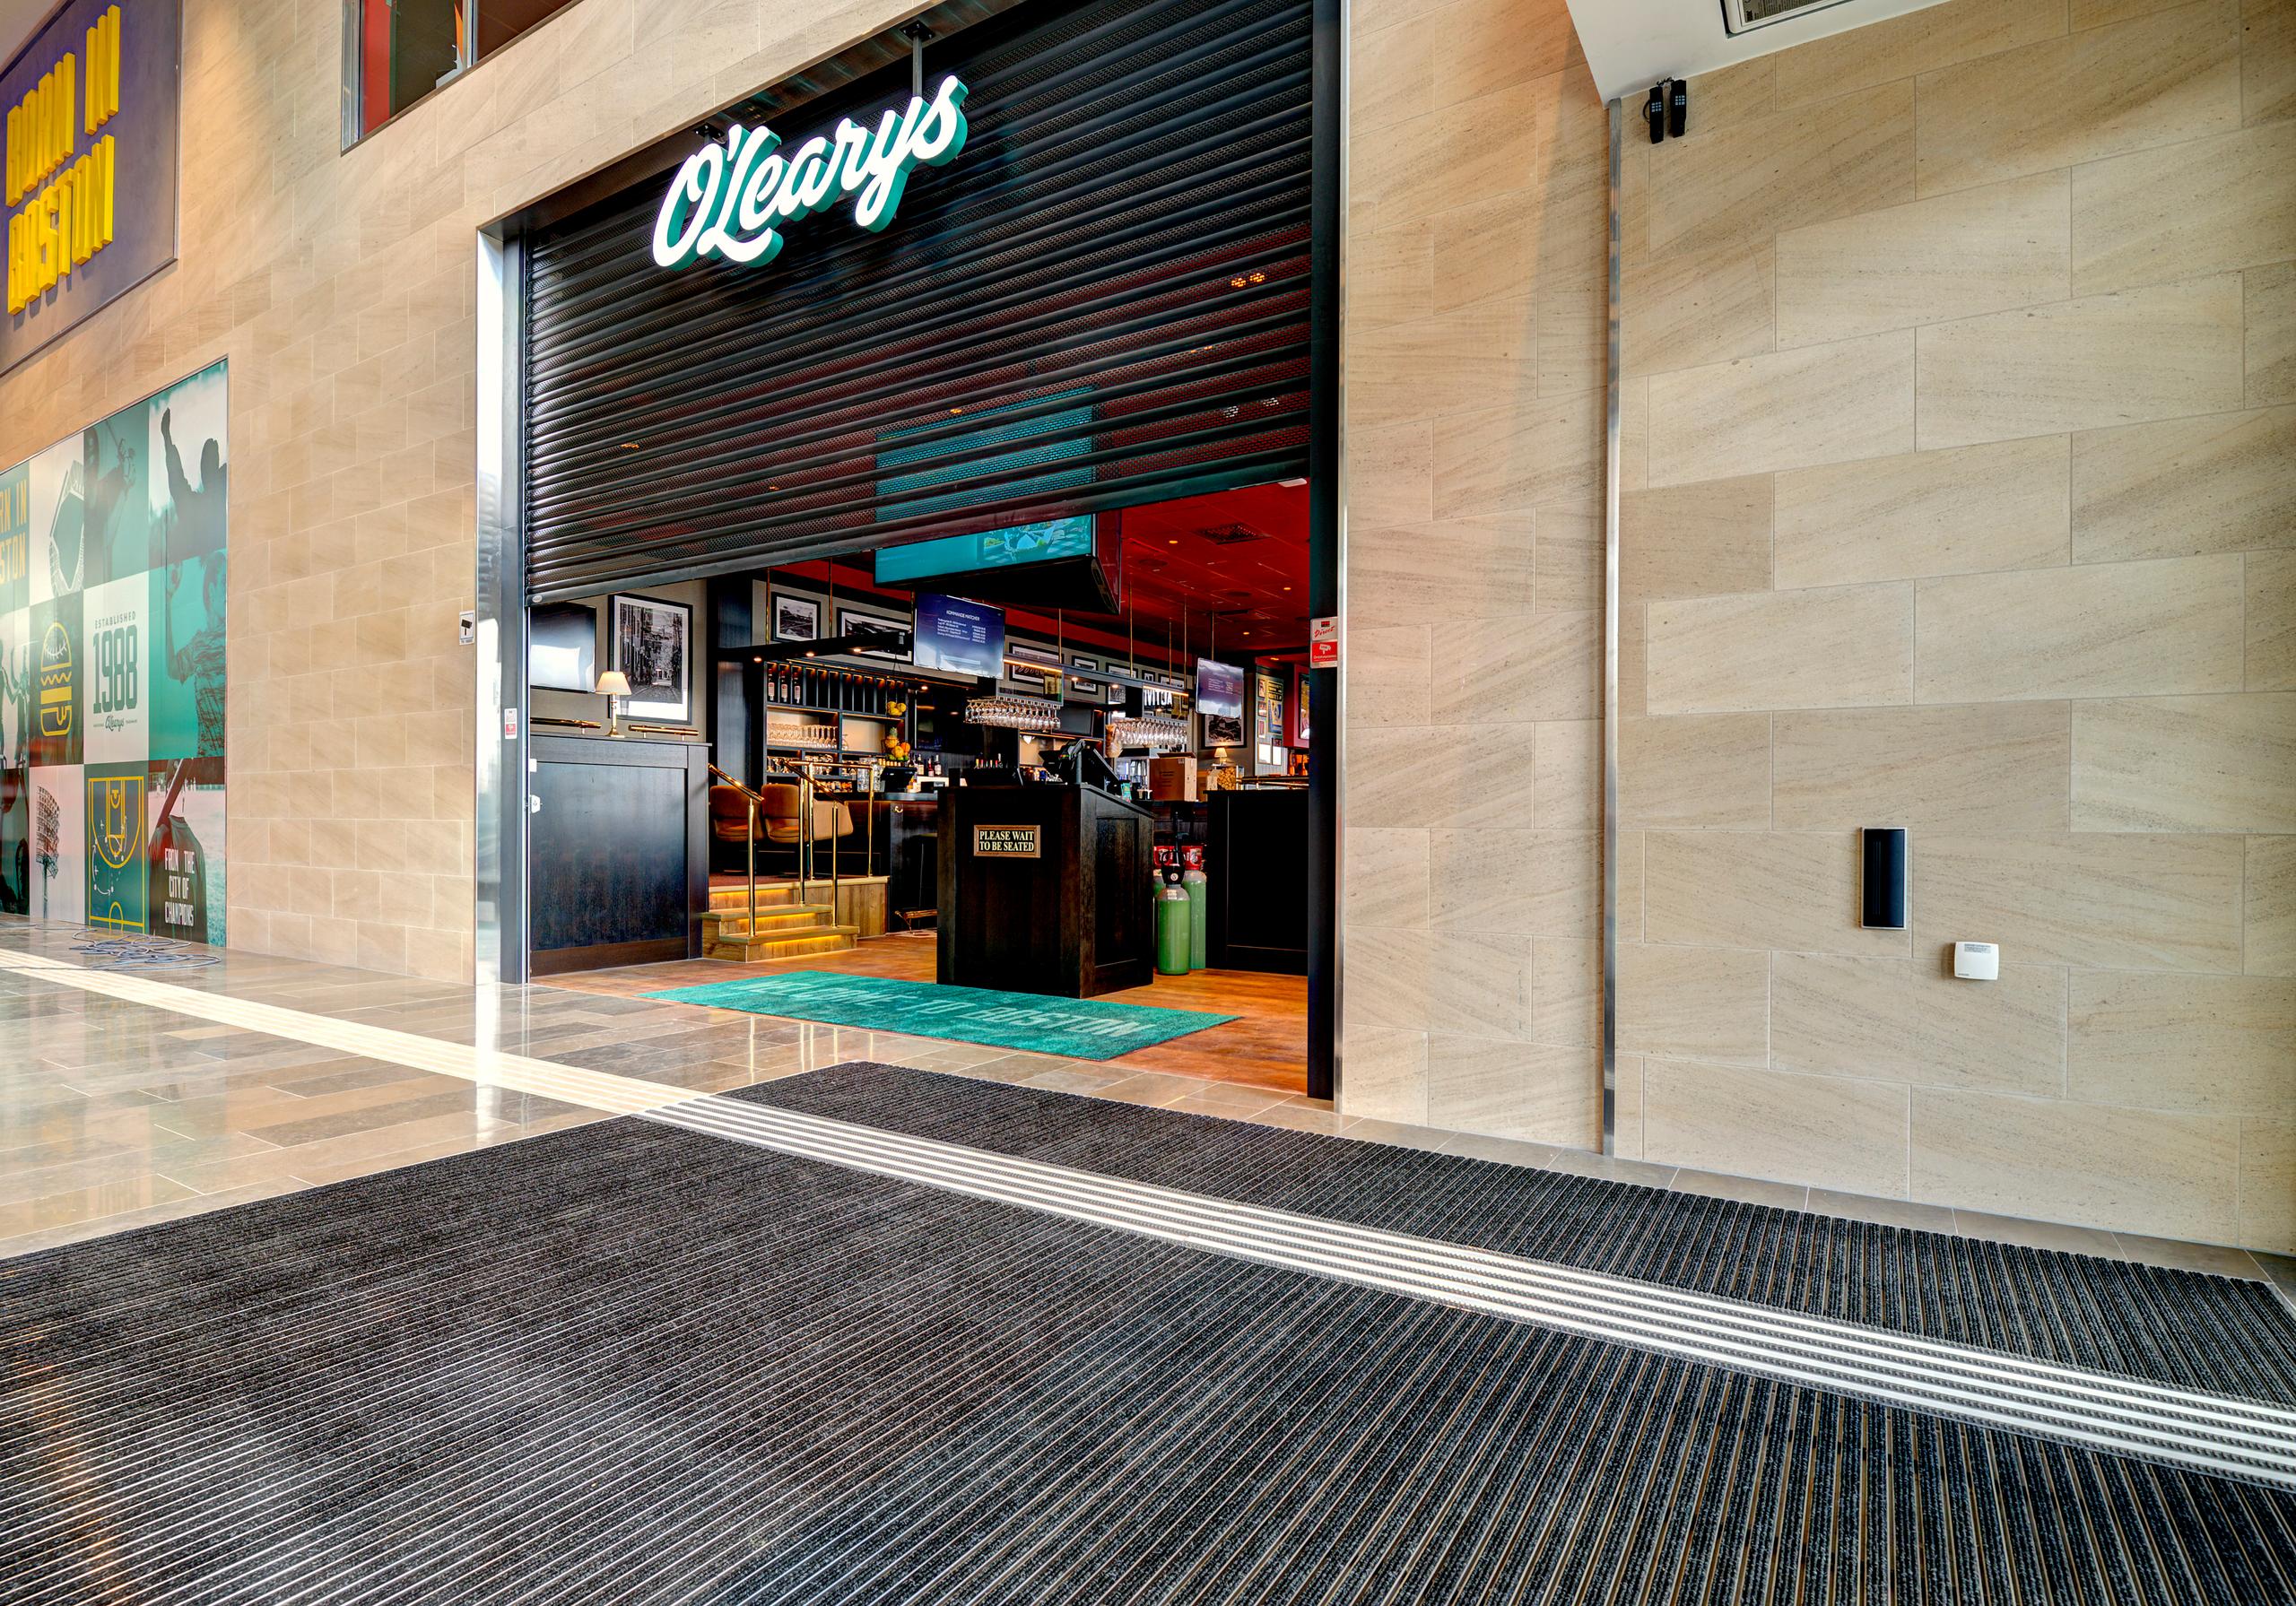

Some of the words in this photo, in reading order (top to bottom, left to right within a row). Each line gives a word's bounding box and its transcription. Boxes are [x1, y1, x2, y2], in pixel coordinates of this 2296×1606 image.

[653, 75, 968, 270] O'Learys
[8, 135, 115, 315] BOSTON
[94, 611, 136, 629] ESTABLISHED
[93, 624, 137, 714] 1988
[979, 830, 1011, 841] PLEASE
[1012, 830, 1035, 841] WAIT
[979, 841, 991, 851] TO
[992, 841, 1003, 851] BE
[1003, 841, 1034, 852] SEATED
[164, 847, 179, 872] FROM
[183, 850, 196, 874] THE
[169, 874, 181, 898] CITY
[182, 877, 190, 899] OF
[164, 901, 195, 927] CHAMPIONS
[897, 999, 978, 1014] TO
[955, 1006, 1158, 1037] BOSTON
